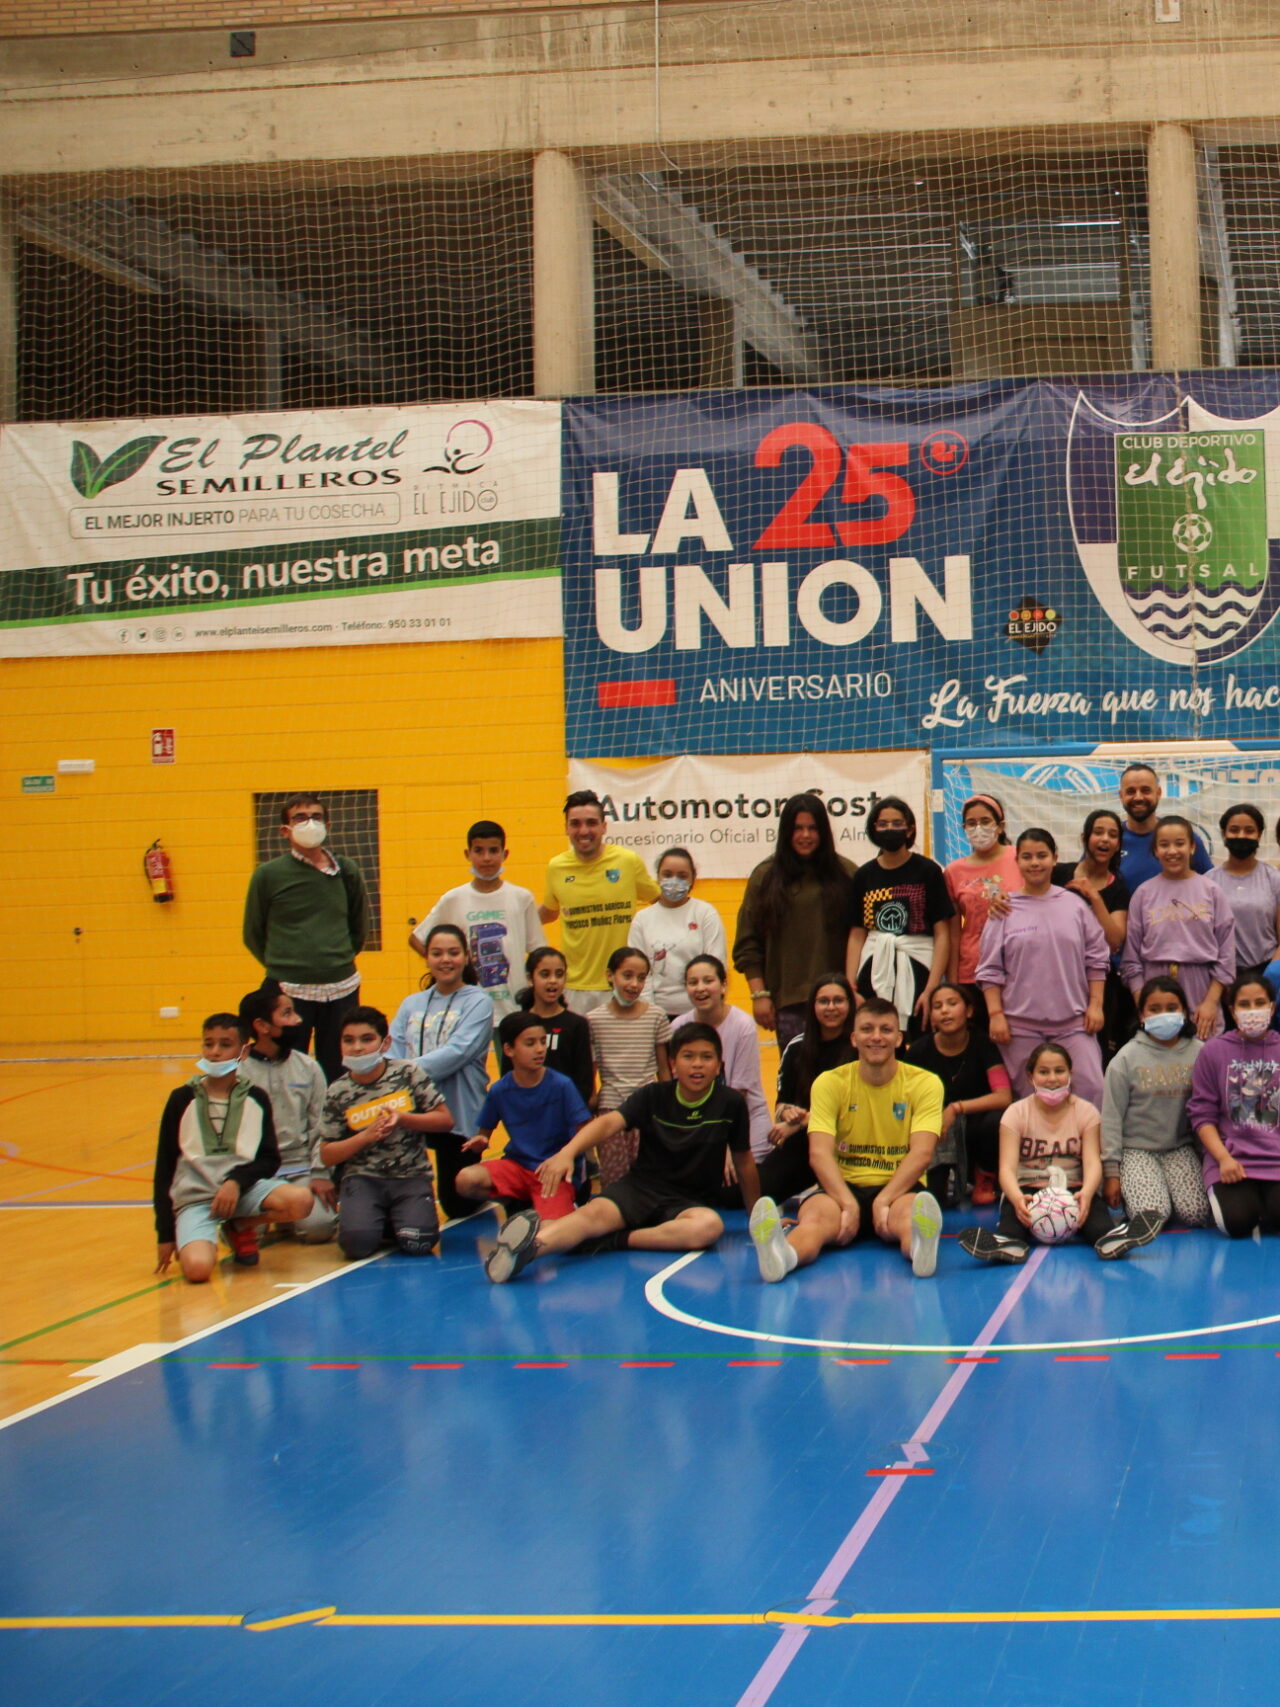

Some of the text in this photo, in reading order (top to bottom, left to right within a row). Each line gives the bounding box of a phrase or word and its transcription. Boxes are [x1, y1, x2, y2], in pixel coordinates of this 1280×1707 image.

[158, 429, 410, 475] El Plantel
[1122, 433, 1257, 450] CLUB DEPORTIVO
[156, 467, 403, 497] SEMILLEROS
[750, 421, 917, 550] 25
[84, 502, 387, 530] EL MEJOR INJERTO PARA TU COSECHA
[592, 467, 734, 556] LA
[66, 536, 502, 606] Tu éxito, nuestra meta
[1128, 563, 1261, 581] FUTSAL
[594, 555, 974, 653] UNION
[340, 619, 386, 632] Teléfono:
[387, 619, 407, 630] 950
[424, 617, 437, 628] 01
[438, 616, 452, 628] 01
[1008, 621, 1057, 634] EL EJIDO
[699, 671, 893, 704] ANIVERSARIO
[921, 677, 976, 730] La
[984, 674, 1093, 723] Fuerza
[1102, 687, 1159, 725] que
[1168, 684, 1217, 712] nos
[600, 792, 790, 823] Automotor
[605, 828, 706, 847] oncesionario
[709, 826, 761, 844] Oficial
[466, 909, 506, 922] GAME
